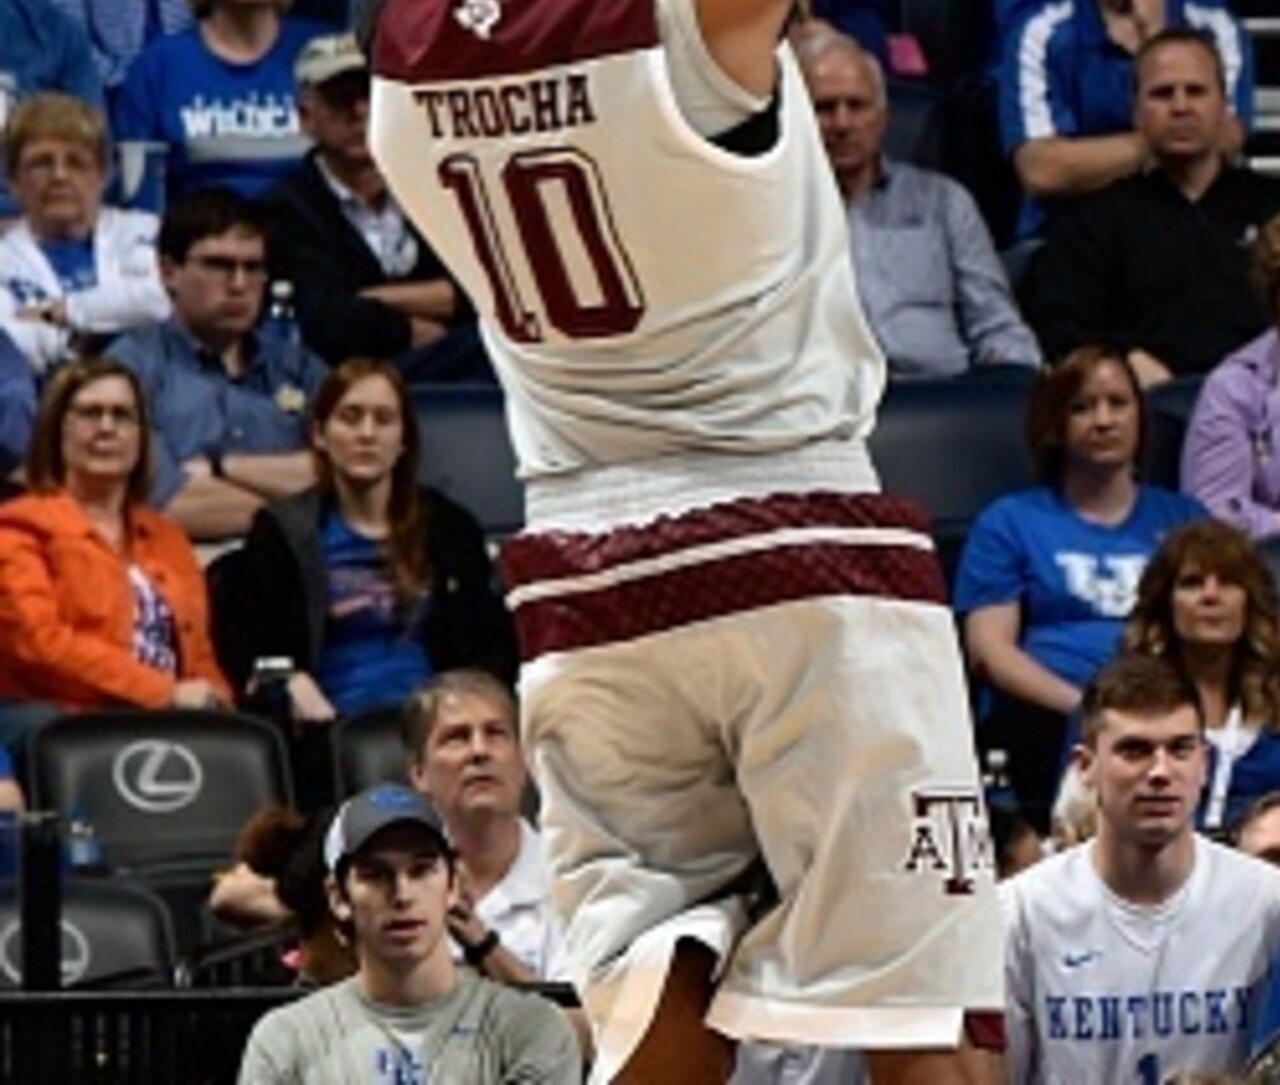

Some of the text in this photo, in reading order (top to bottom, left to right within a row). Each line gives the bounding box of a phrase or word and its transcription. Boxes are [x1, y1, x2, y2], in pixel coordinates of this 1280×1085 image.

[413, 74, 597, 138] TROCHA
[437, 147, 646, 343] 10
[1046, 987, 1254, 1040] KENTUCKY
